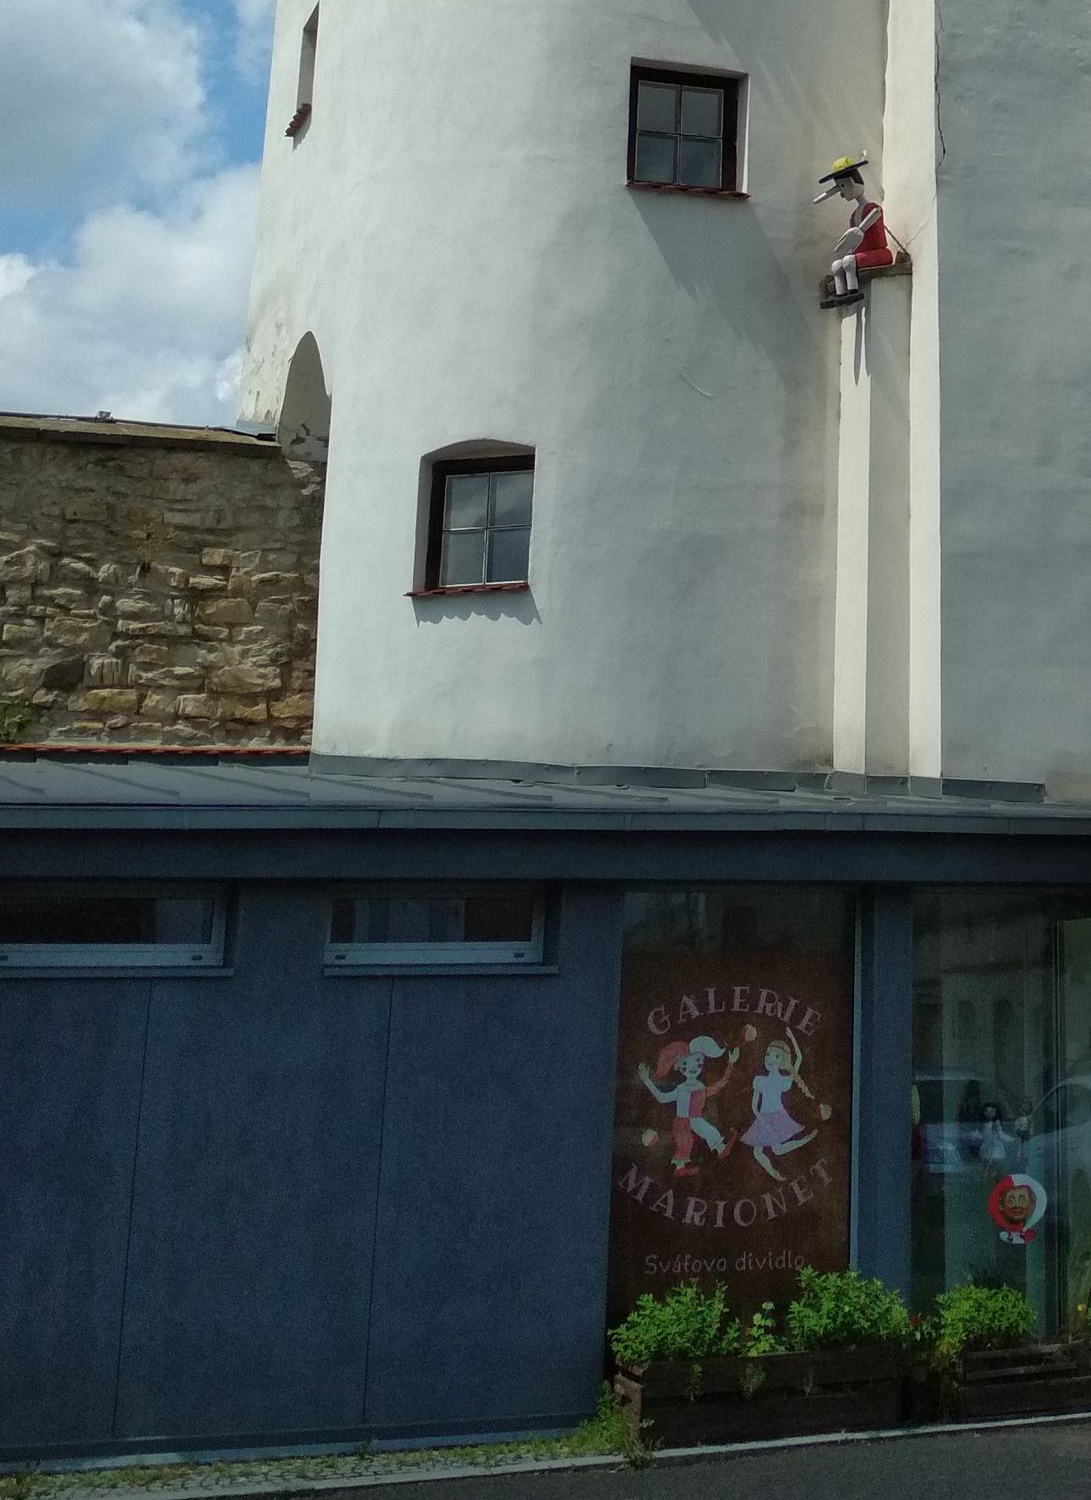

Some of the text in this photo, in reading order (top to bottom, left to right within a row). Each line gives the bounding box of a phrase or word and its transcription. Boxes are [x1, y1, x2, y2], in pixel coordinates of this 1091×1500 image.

[647, 985, 822, 1037] GALERIE
[617, 1157, 833, 1228] MARIONET
[734, 1250, 805, 1271] dividlo
